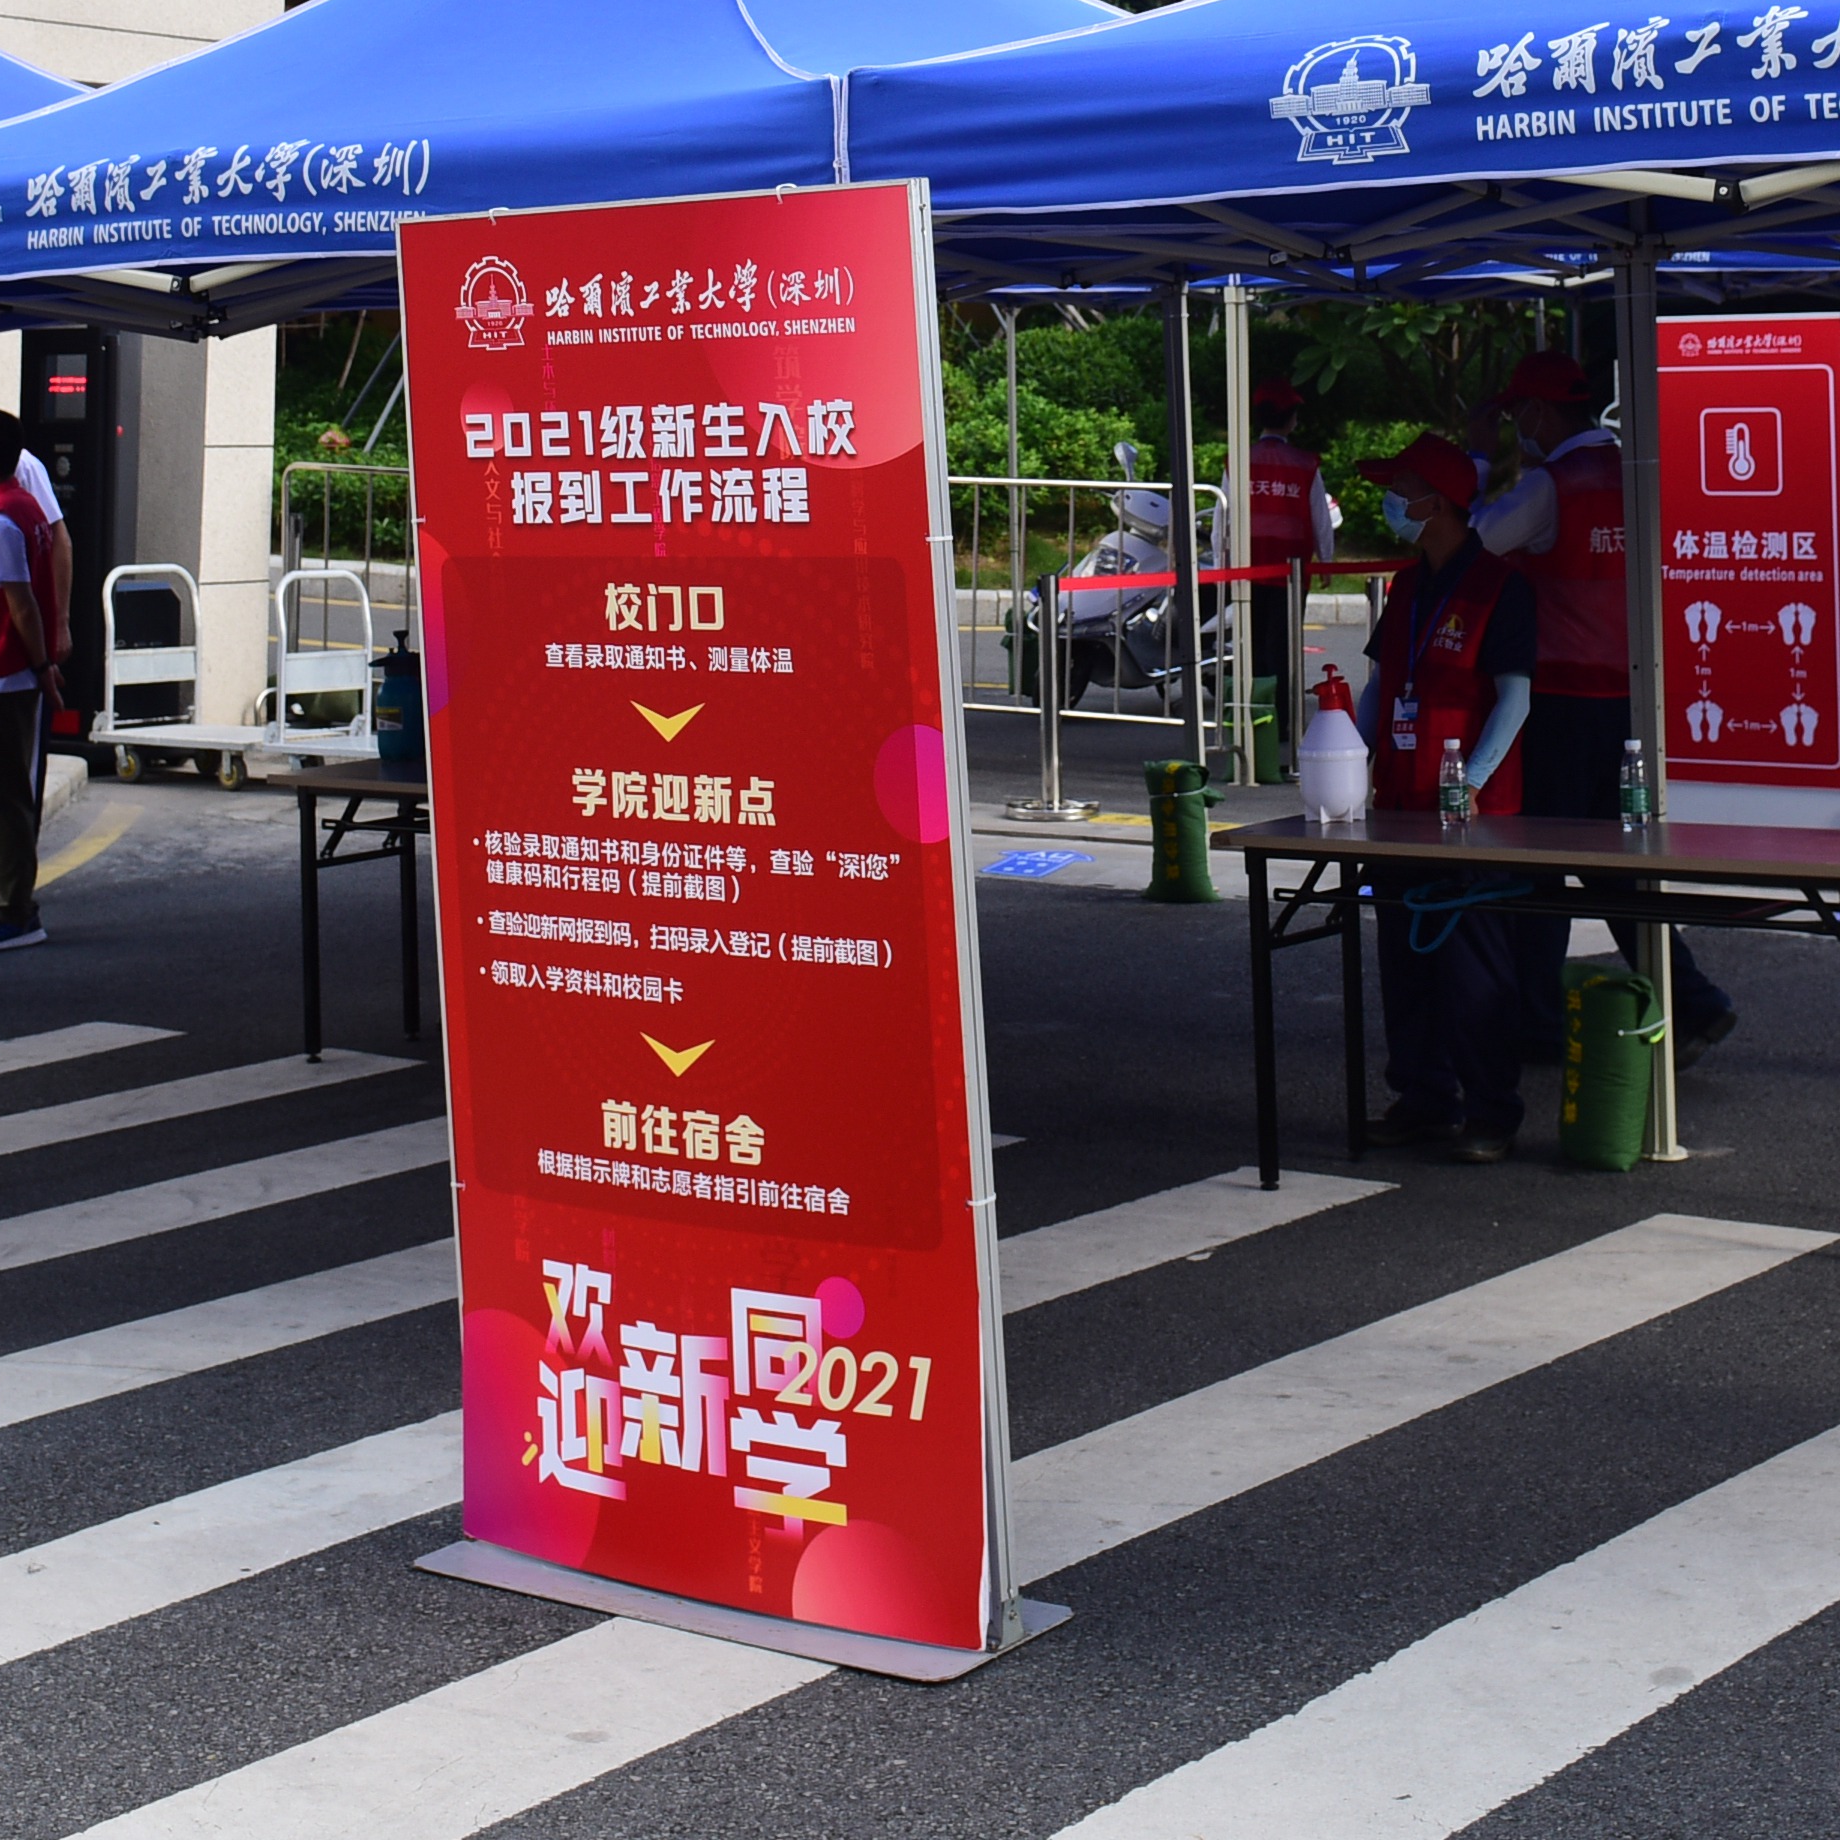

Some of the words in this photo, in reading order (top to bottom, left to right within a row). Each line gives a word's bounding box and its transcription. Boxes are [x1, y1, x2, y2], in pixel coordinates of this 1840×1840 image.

[1326, 131, 1376, 147] HIT
[1336, 114, 1367, 126] 1920
[1476, 108, 1576, 142] HARBIN
[1593, 98, 1733, 133] INSTITUTE
[1749, 95, 1786, 123] OF
[27, 228, 84, 251] HARBIN
[92, 220, 172, 246] INSTITUTE
[181, 217, 202, 239] OF
[211, 212, 328, 238] TECHNOLOGY,
[482, 330, 508, 339] HIT
[547, 326, 593, 346] HARBIN
[598, 324, 662, 343] INSTITUTE
[667, 323, 684, 341] OF
[690, 320, 780, 340] TECHNOLOGY,
[784, 316, 856, 335] SHENZHEN
[465, 399, 857, 459] 2021级新生入校
[511, 467, 810, 525] 报到工作流程
[1673, 529, 1818, 561] 体温检测区
[1661, 565, 1735, 584] Temperature
[1740, 566, 1796, 583] detection
[1797, 568, 1824, 584] area
[605, 583, 724, 632] 校门口
[545, 643, 794, 673] 查看录取通知书、测量体温
[572, 768, 776, 827] 学院迎新点
[491, 960, 684, 1005] 领取入学资料和校园卡
[601, 1098, 765, 1166] 前往宿舍
[538, 1148, 850, 1216] 根据指示牌和志愿者指引前往宿舍
[775, 1340, 932, 1422] 2021
